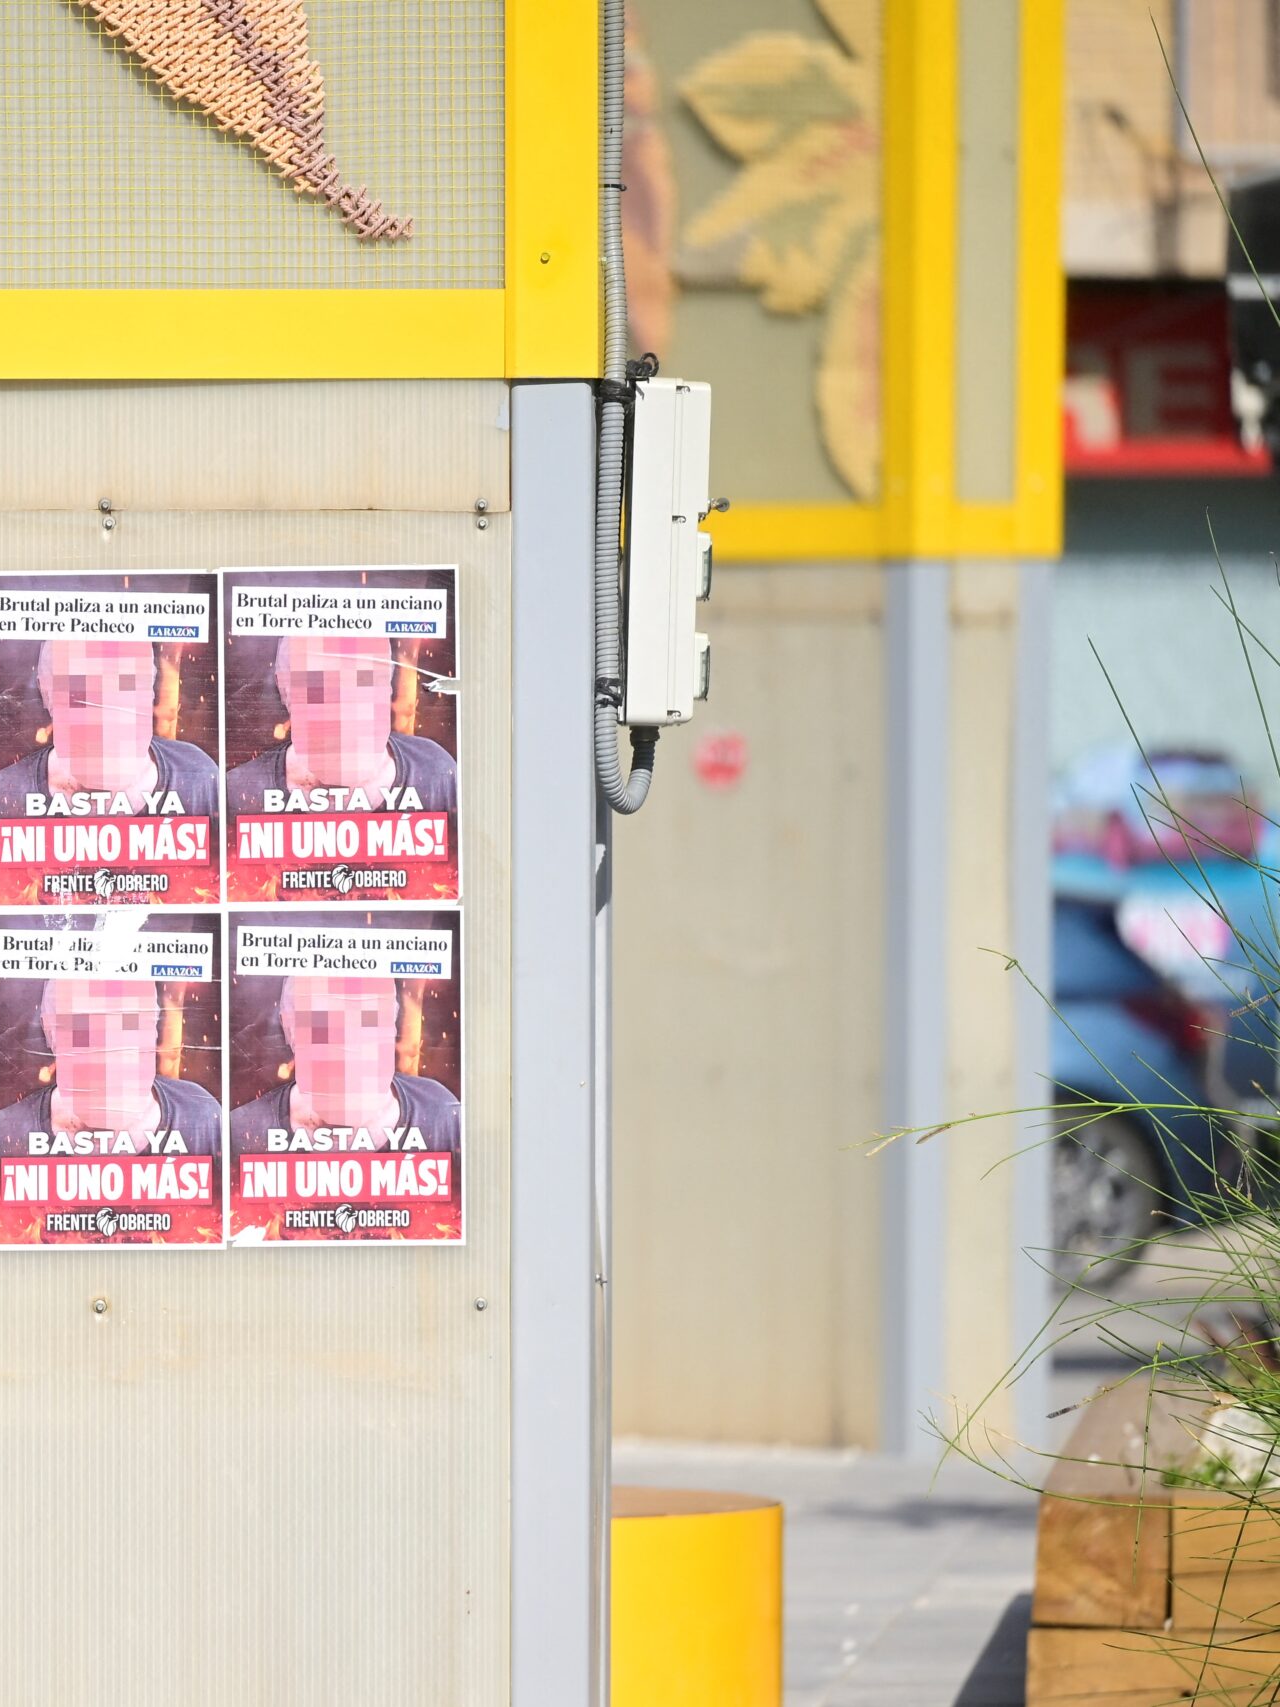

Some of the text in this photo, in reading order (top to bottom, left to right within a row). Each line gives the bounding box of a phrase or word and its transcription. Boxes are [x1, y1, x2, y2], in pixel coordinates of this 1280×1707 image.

[0, 597, 205, 616] Brutal paliza a un anciano
[237, 593, 443, 612] Brutal paliza a un anciano
[0, 617, 135, 633] en Torre Pacheco
[236, 613, 372, 629] en Torre Pacheco
[26, 791, 185, 816] BASTA YA
[264, 787, 424, 812] BASTA YA
[1, 818, 207, 862] ¡NI UNO MÁS!
[239, 814, 445, 859] ¡NI UNO MÁS!
[44, 874, 168, 892] FRENTE OBRERO
[282, 870, 406, 888] FRENTE OBRERO
[3, 936, 53, 951] Brutal
[147, 940, 209, 954] anciano
[242, 932, 448, 951] Brutal paliza a un anciano
[2, 959, 20, 970] en
[241, 953, 377, 969] en Torre Pacheco
[28, 1130, 188, 1155] BASTA YA
[267, 1127, 427, 1151] BASTA YA
[4, 1157, 209, 1201] ¡NI UNO MÁS!
[242, 1154, 449, 1198] ¡NI UNO MÁS!
[47, 1214, 170, 1231] FRENTE OBRERO
[286, 1210, 409, 1227] FRENTE OBRERO
